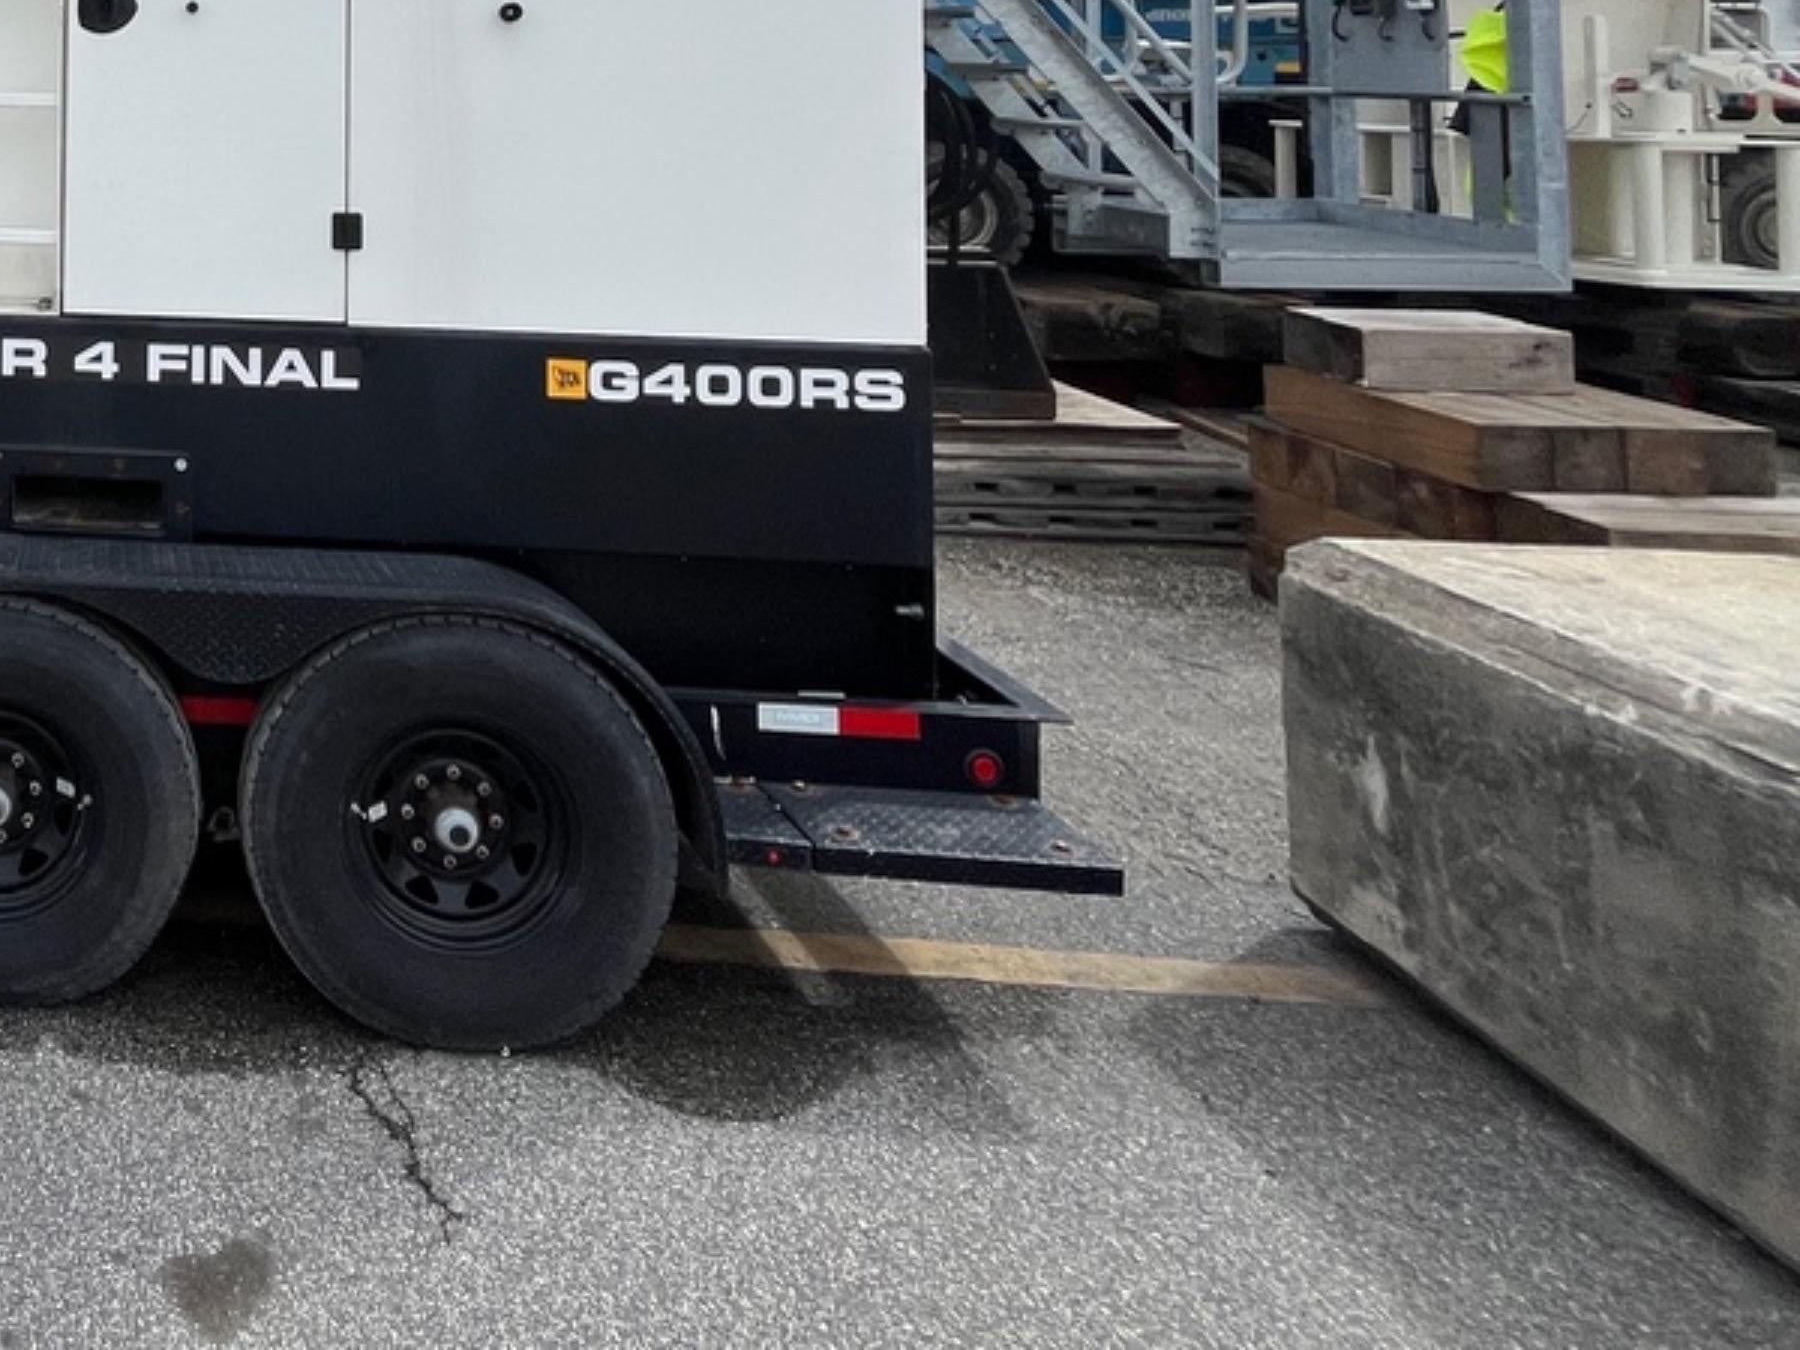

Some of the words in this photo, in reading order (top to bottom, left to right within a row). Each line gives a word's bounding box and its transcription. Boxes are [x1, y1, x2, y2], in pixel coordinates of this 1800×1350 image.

[73, 341, 119, 380] 4
[146, 342, 361, 391] FINAL
[588, 359, 906, 412] G400RS
